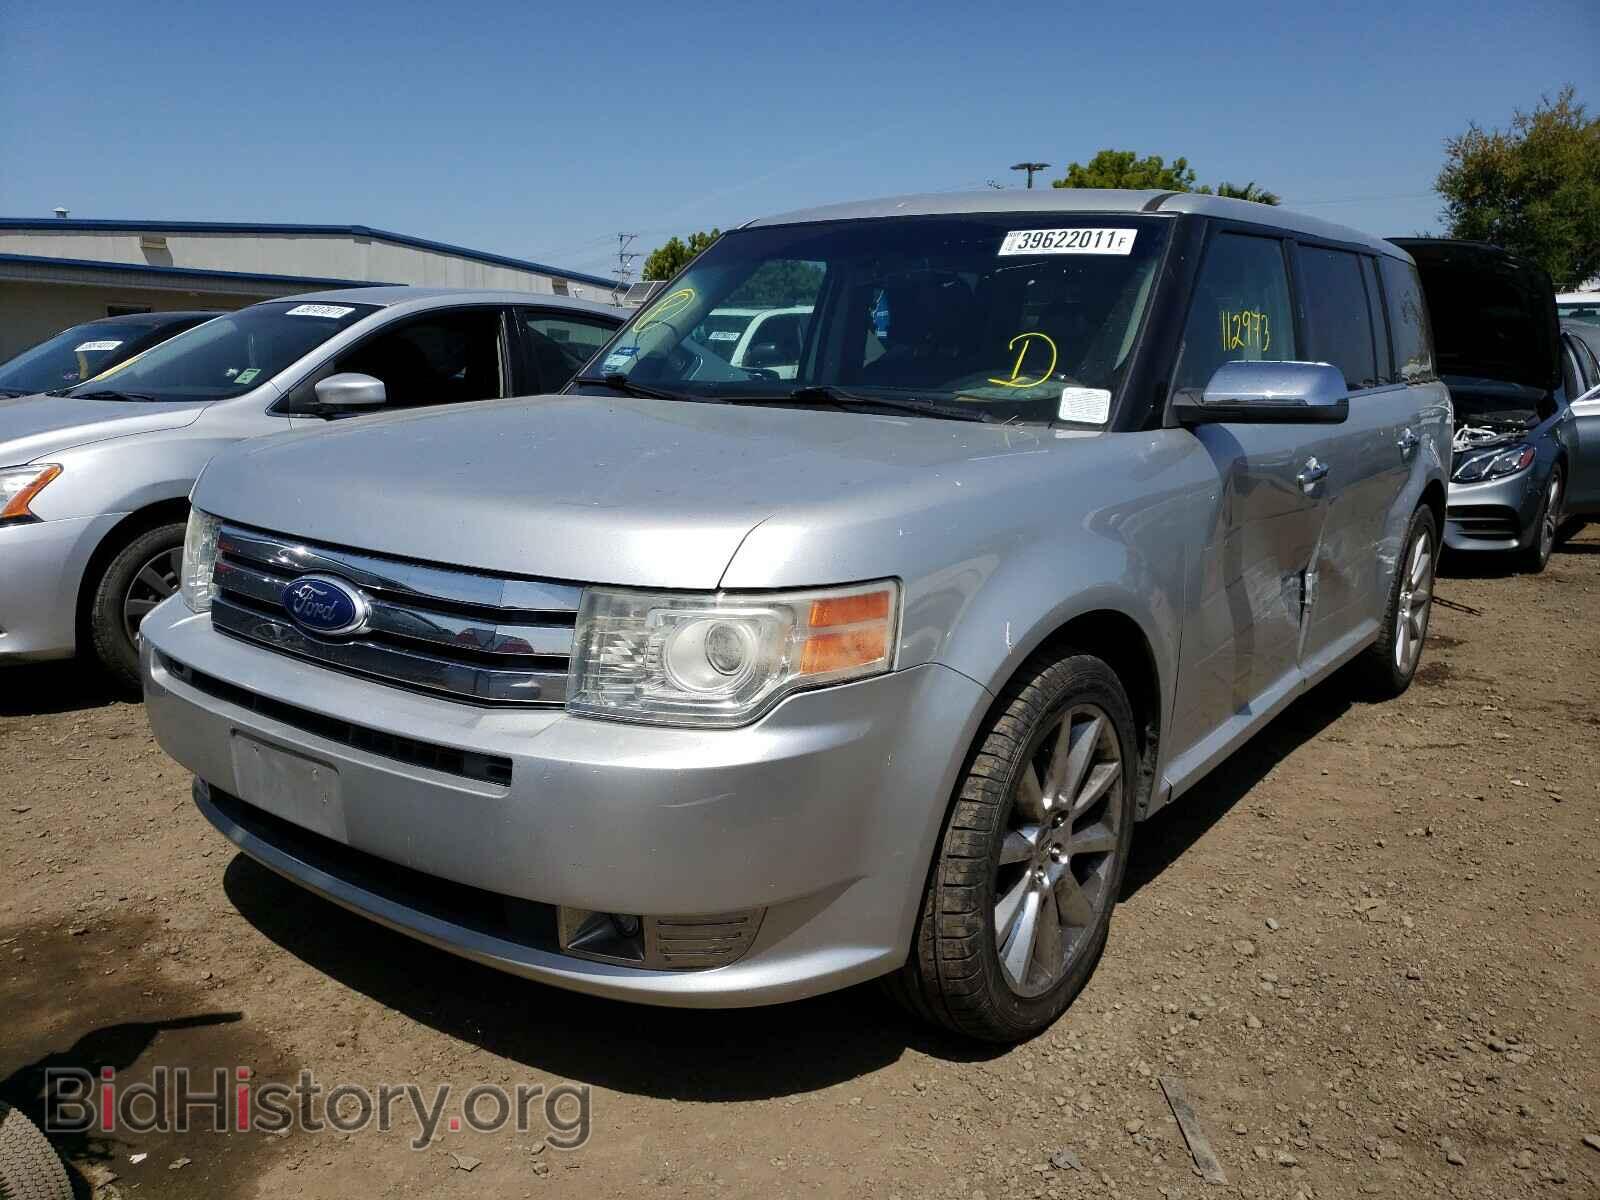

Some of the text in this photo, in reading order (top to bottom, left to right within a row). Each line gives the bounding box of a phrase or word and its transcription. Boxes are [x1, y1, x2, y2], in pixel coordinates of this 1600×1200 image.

[1018, 230, 1116, 249] 39622011
[987, 332, 1057, 388] D
[292, 584, 339, 621] Ford
